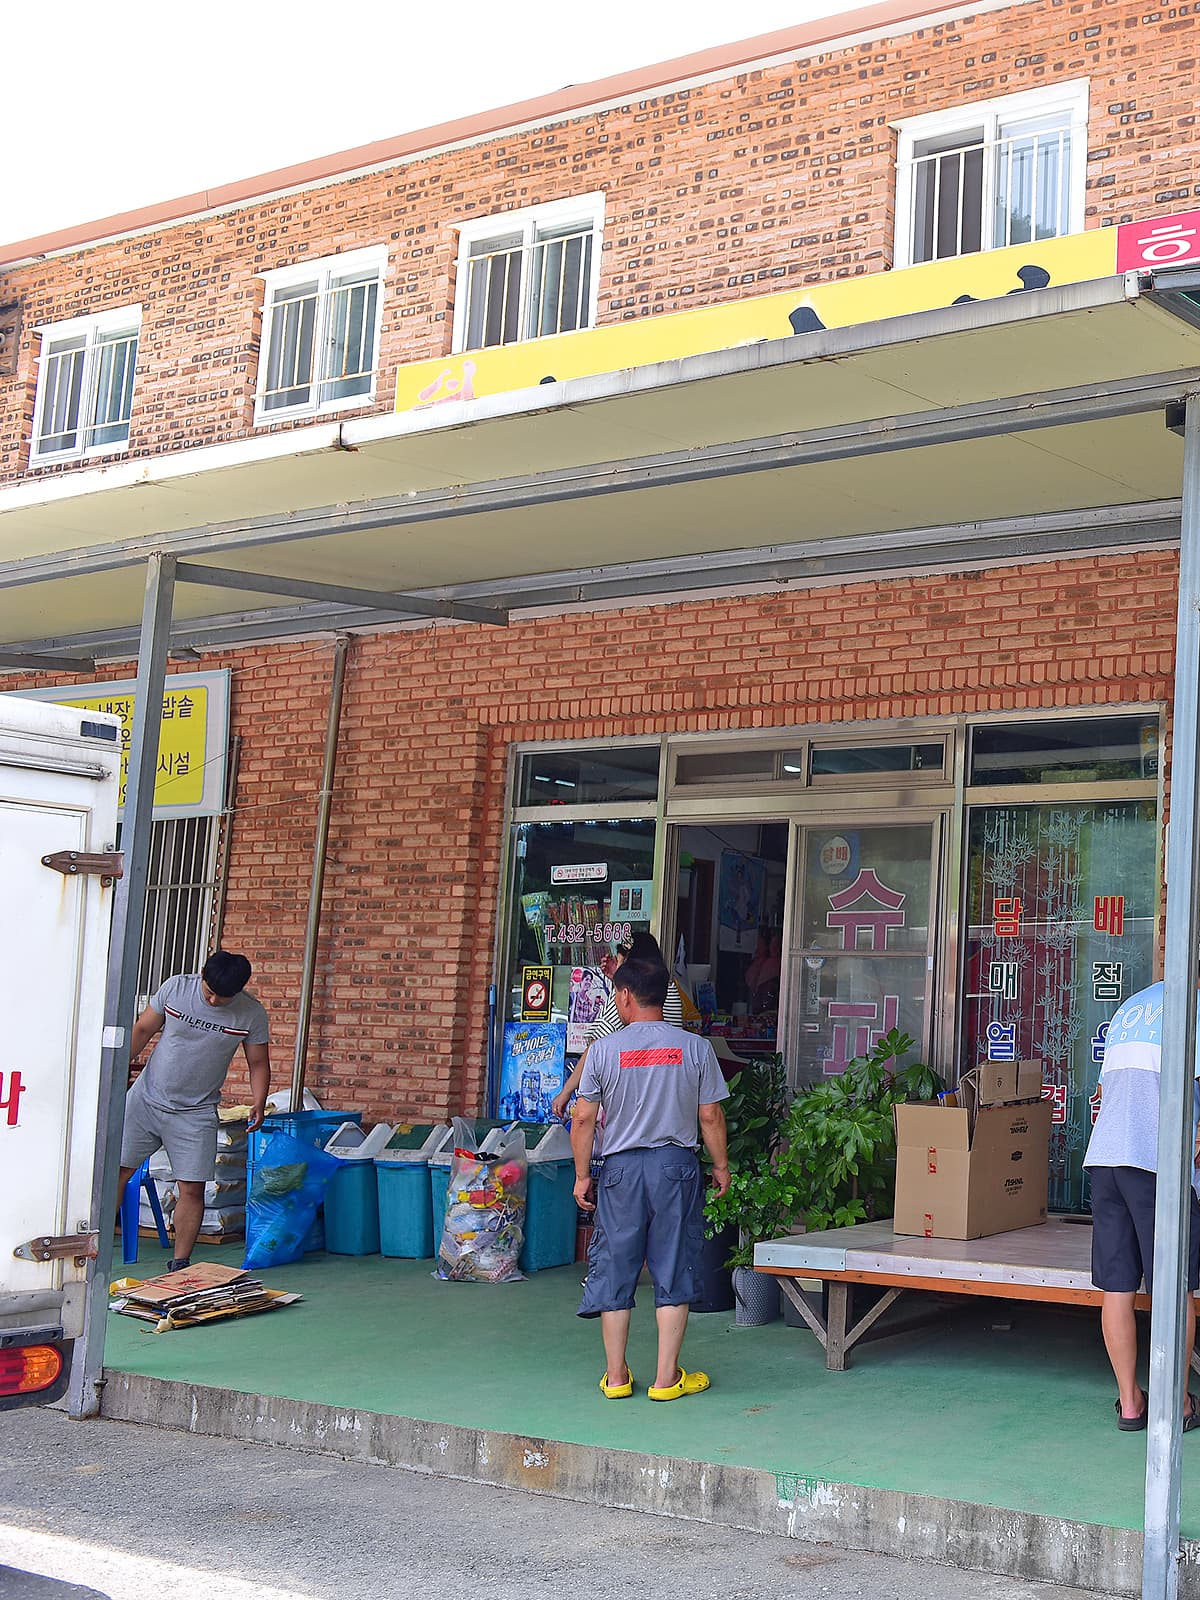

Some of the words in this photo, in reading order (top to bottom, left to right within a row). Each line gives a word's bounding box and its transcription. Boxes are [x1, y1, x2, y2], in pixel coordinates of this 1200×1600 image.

[161, 694, 194, 719] 밥솥
[157, 751, 190, 776] 시설
[525, 969, 550, 981] 금연구역
[178, 1012, 225, 1033] HILFIGER
